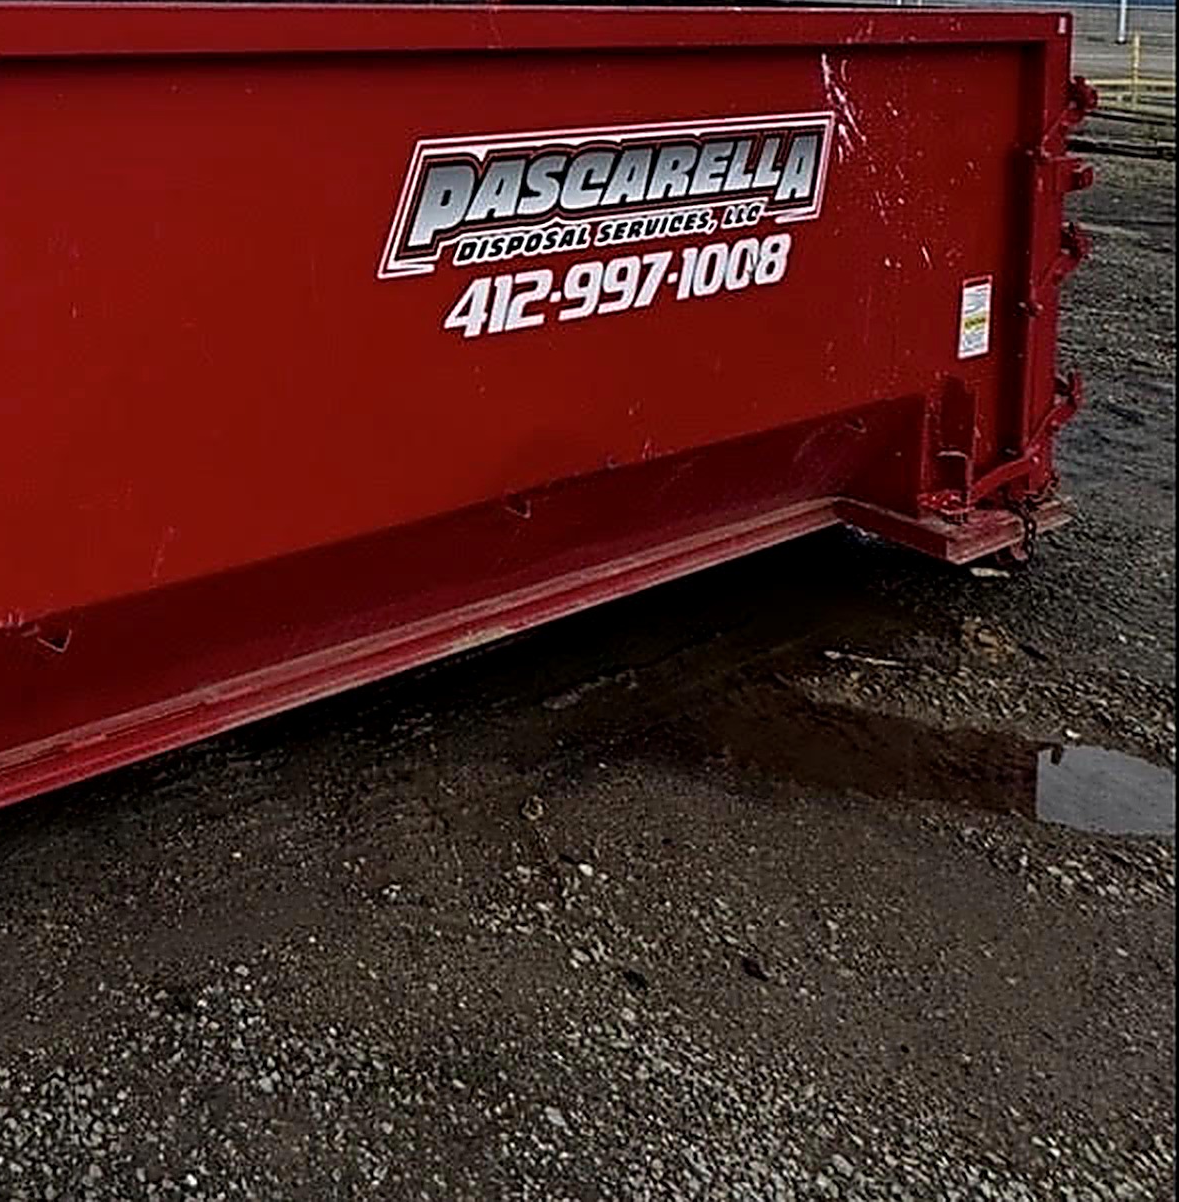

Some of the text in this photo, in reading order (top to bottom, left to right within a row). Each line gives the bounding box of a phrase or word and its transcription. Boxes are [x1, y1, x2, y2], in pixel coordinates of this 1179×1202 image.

[408, 135, 818, 247] PASCARELLA
[456, 203, 764, 263] DISPOSAL SERVICES, LLC
[443, 233, 792, 338] 412-997-1008
